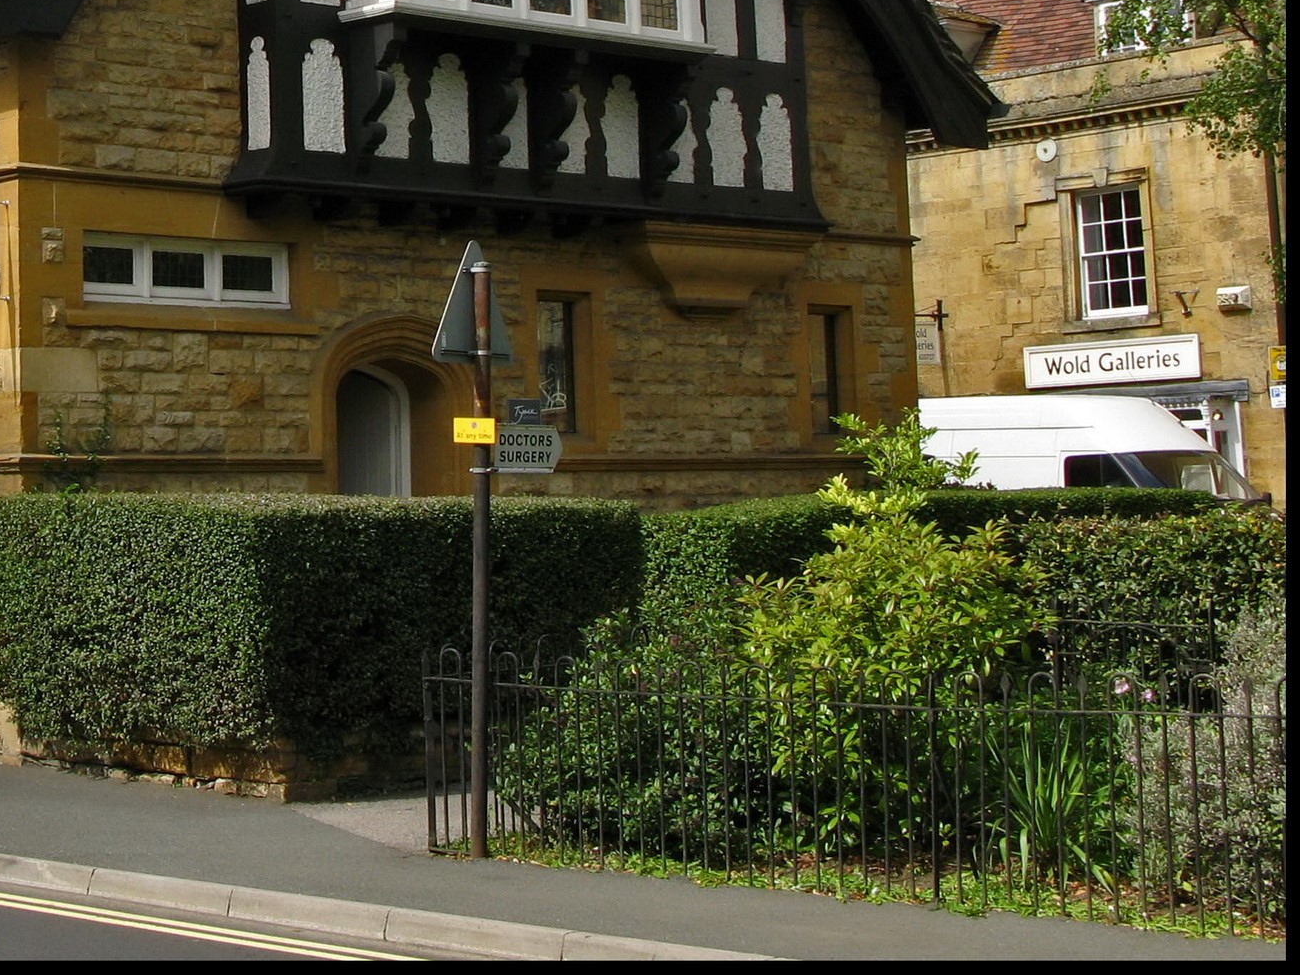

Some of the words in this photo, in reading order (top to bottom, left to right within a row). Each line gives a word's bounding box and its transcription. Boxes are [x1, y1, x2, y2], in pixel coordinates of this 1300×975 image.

[1044, 355, 1091, 376] Wold
[1099, 349, 1181, 372] Galleries
[500, 434, 553, 447] DOCTORS
[499, 450, 552, 463] SURGERY
